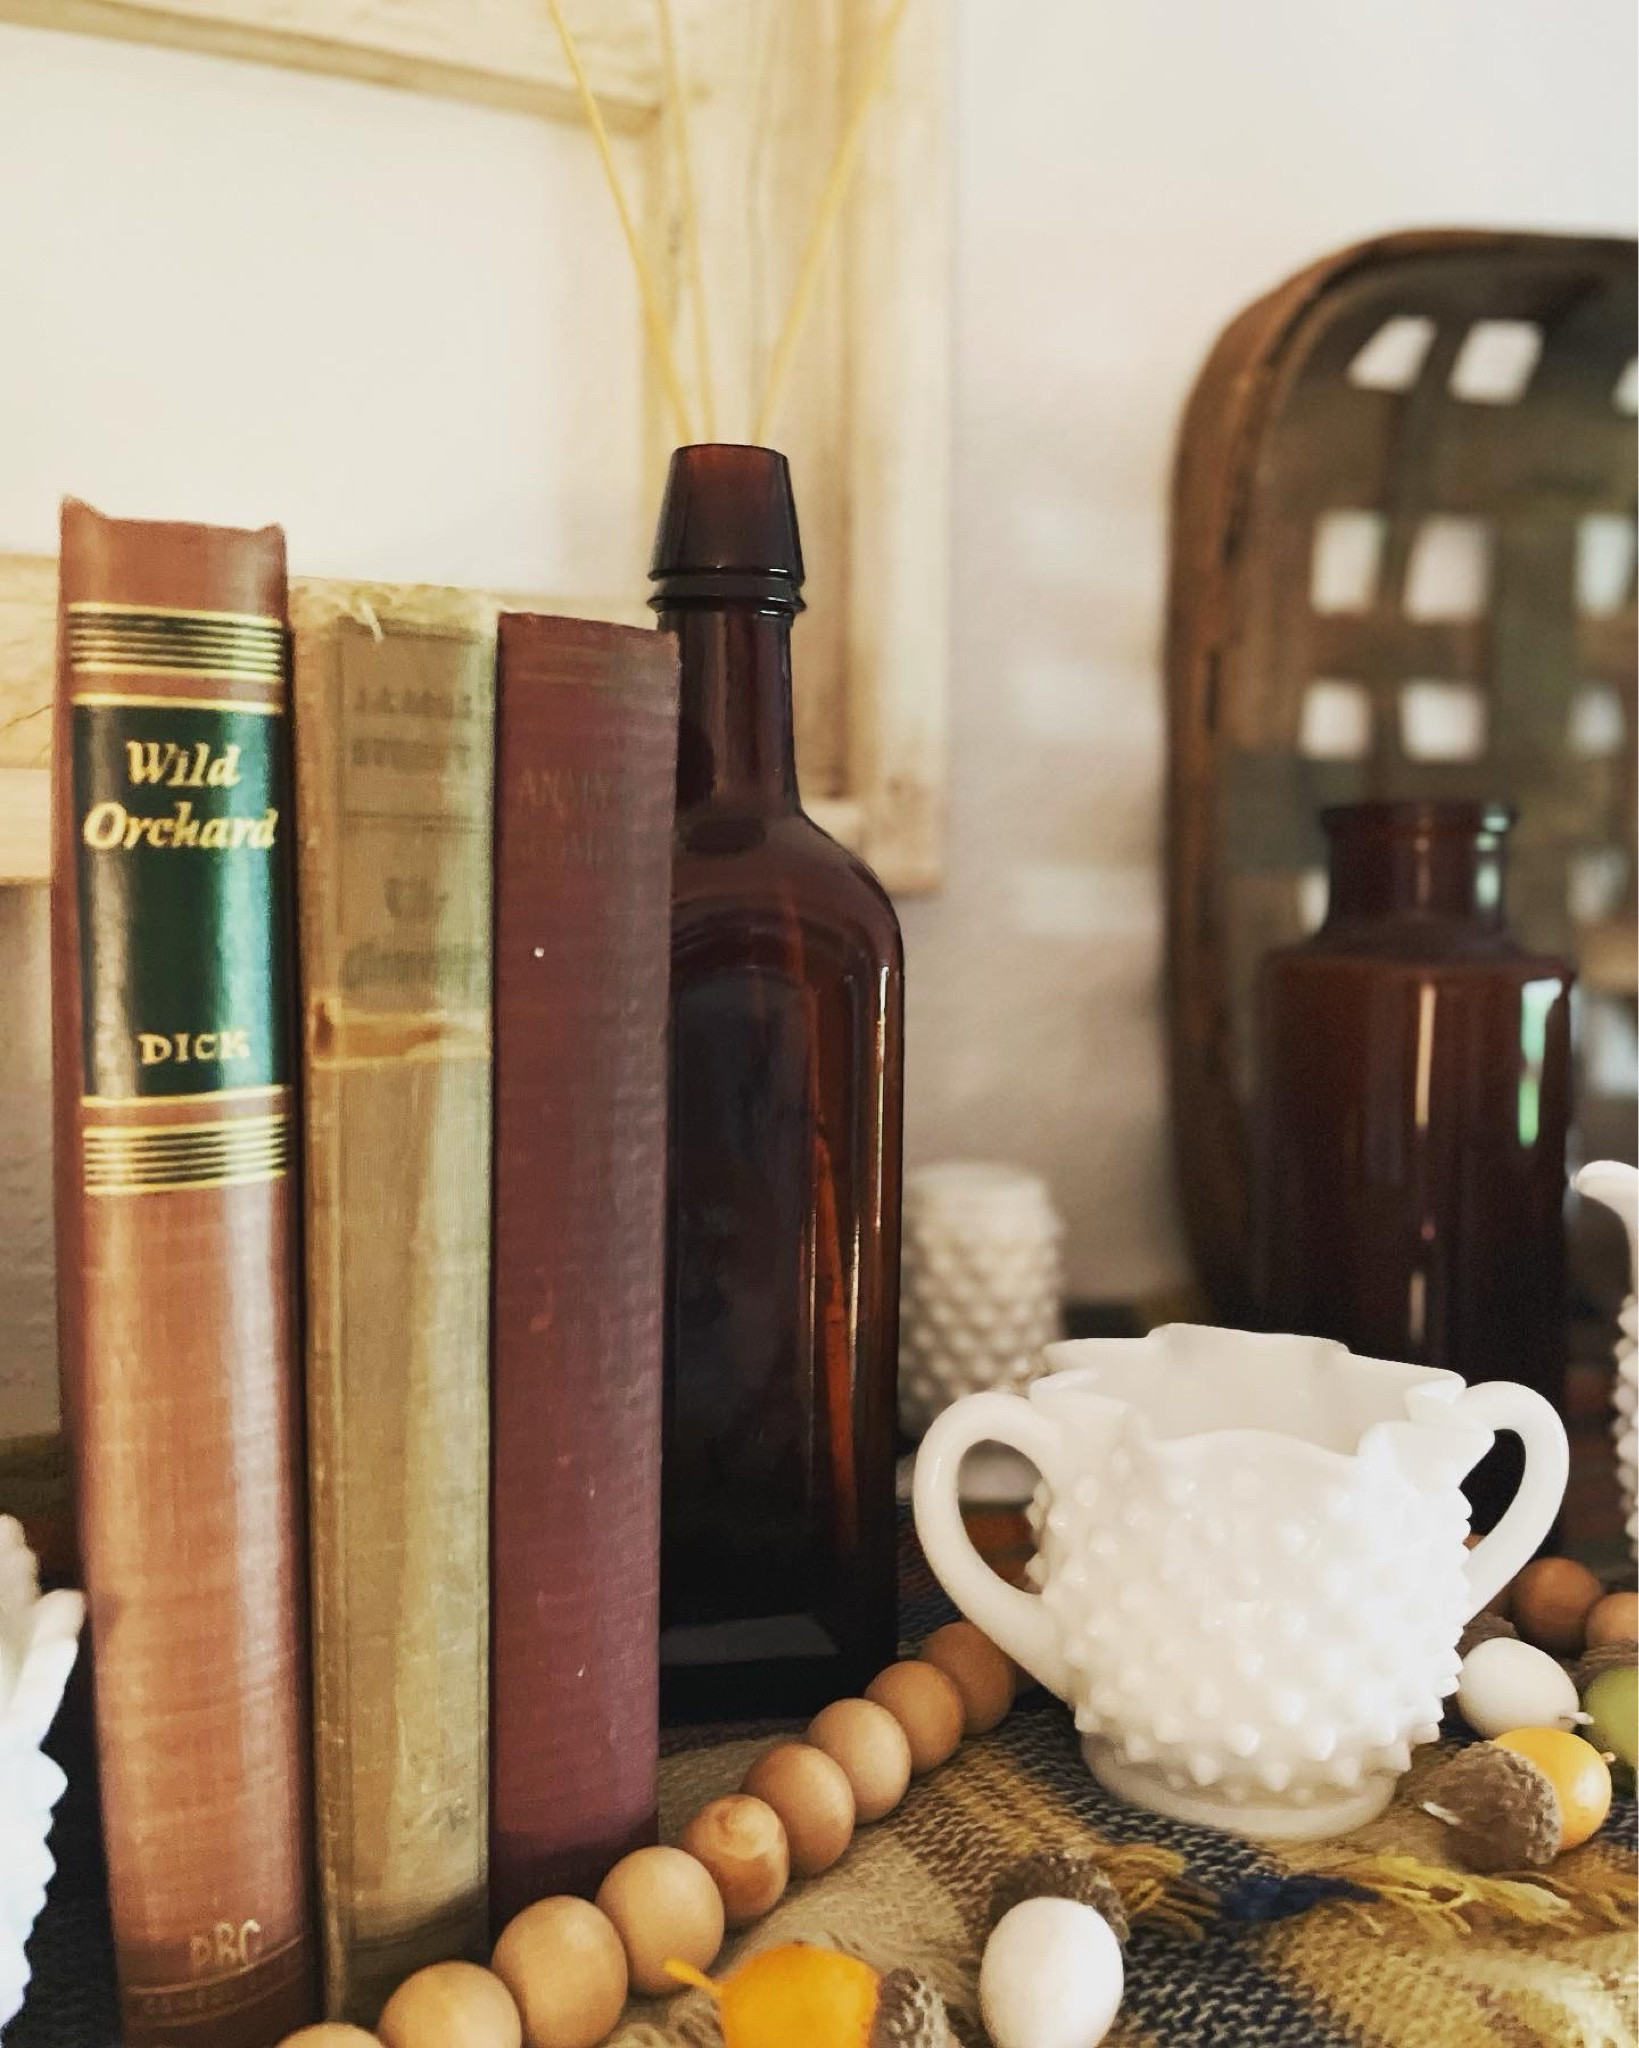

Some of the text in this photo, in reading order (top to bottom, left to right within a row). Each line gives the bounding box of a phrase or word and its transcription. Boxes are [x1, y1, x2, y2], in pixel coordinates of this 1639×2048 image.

[125, 740, 241, 787] Wild
[83, 801, 279, 850] Orchard
[138, 1030, 250, 1065] DICK
